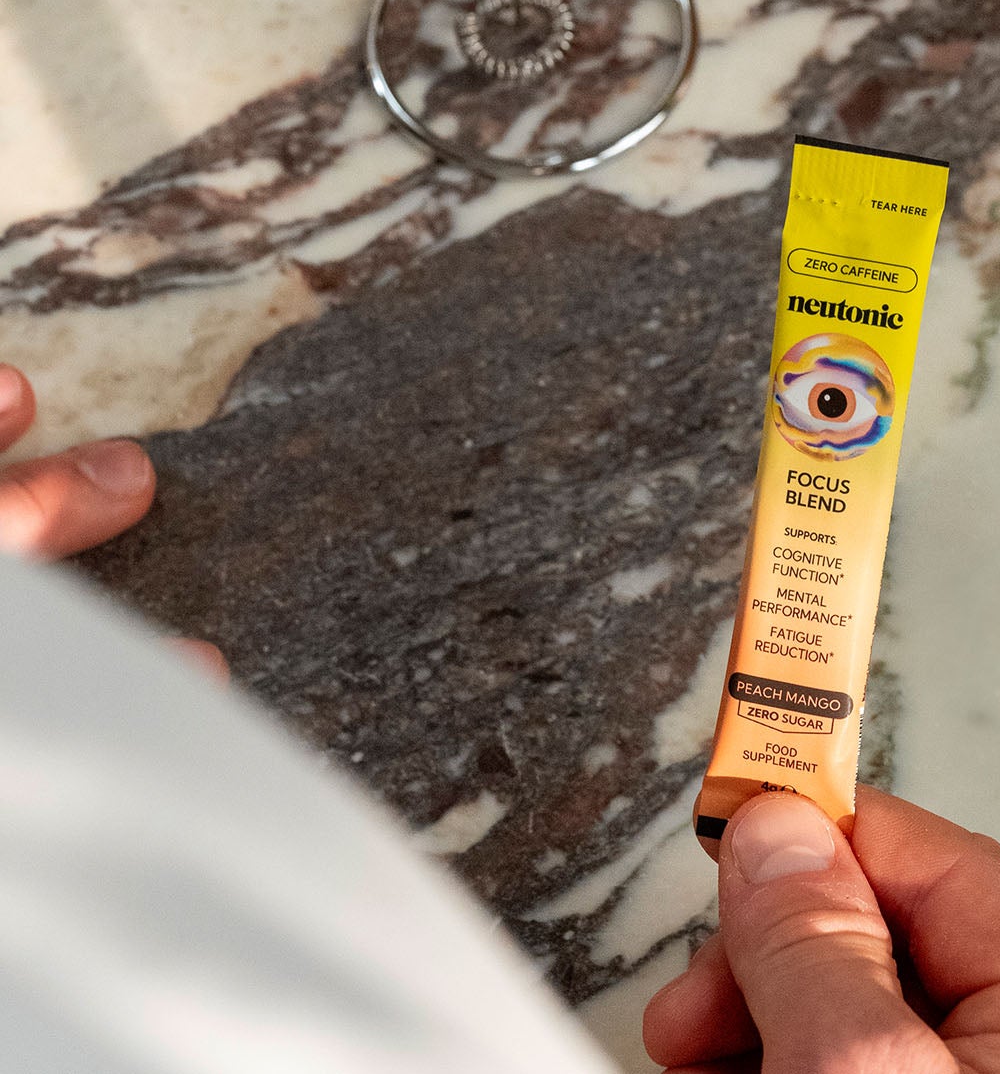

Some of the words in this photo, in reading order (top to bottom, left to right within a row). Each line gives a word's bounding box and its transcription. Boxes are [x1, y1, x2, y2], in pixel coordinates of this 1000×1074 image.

[871, 199, 898, 213] TEAR
[900, 204, 928, 218] HERE
[804, 257, 838, 274] ZERO
[840, 263, 900, 284] CAFFEINE
[787, 294, 904, 331] neutonic
[786, 470, 851, 495] FOCUS
[785, 490, 847, 515] BLEND
[773, 546, 843, 570] COGNITIVE
[776, 587, 827, 608] MENTAL
[769, 626, 823, 647] FATIGUE
[736, 680, 784, 702] PEACH
[785, 690, 842, 712] MANGO
[747, 706, 780, 722] ZERO
[782, 714, 824, 731] SUGAR
[742, 749, 818, 774] SUPPLEMENT
[765, 742, 798, 758] FOOD
